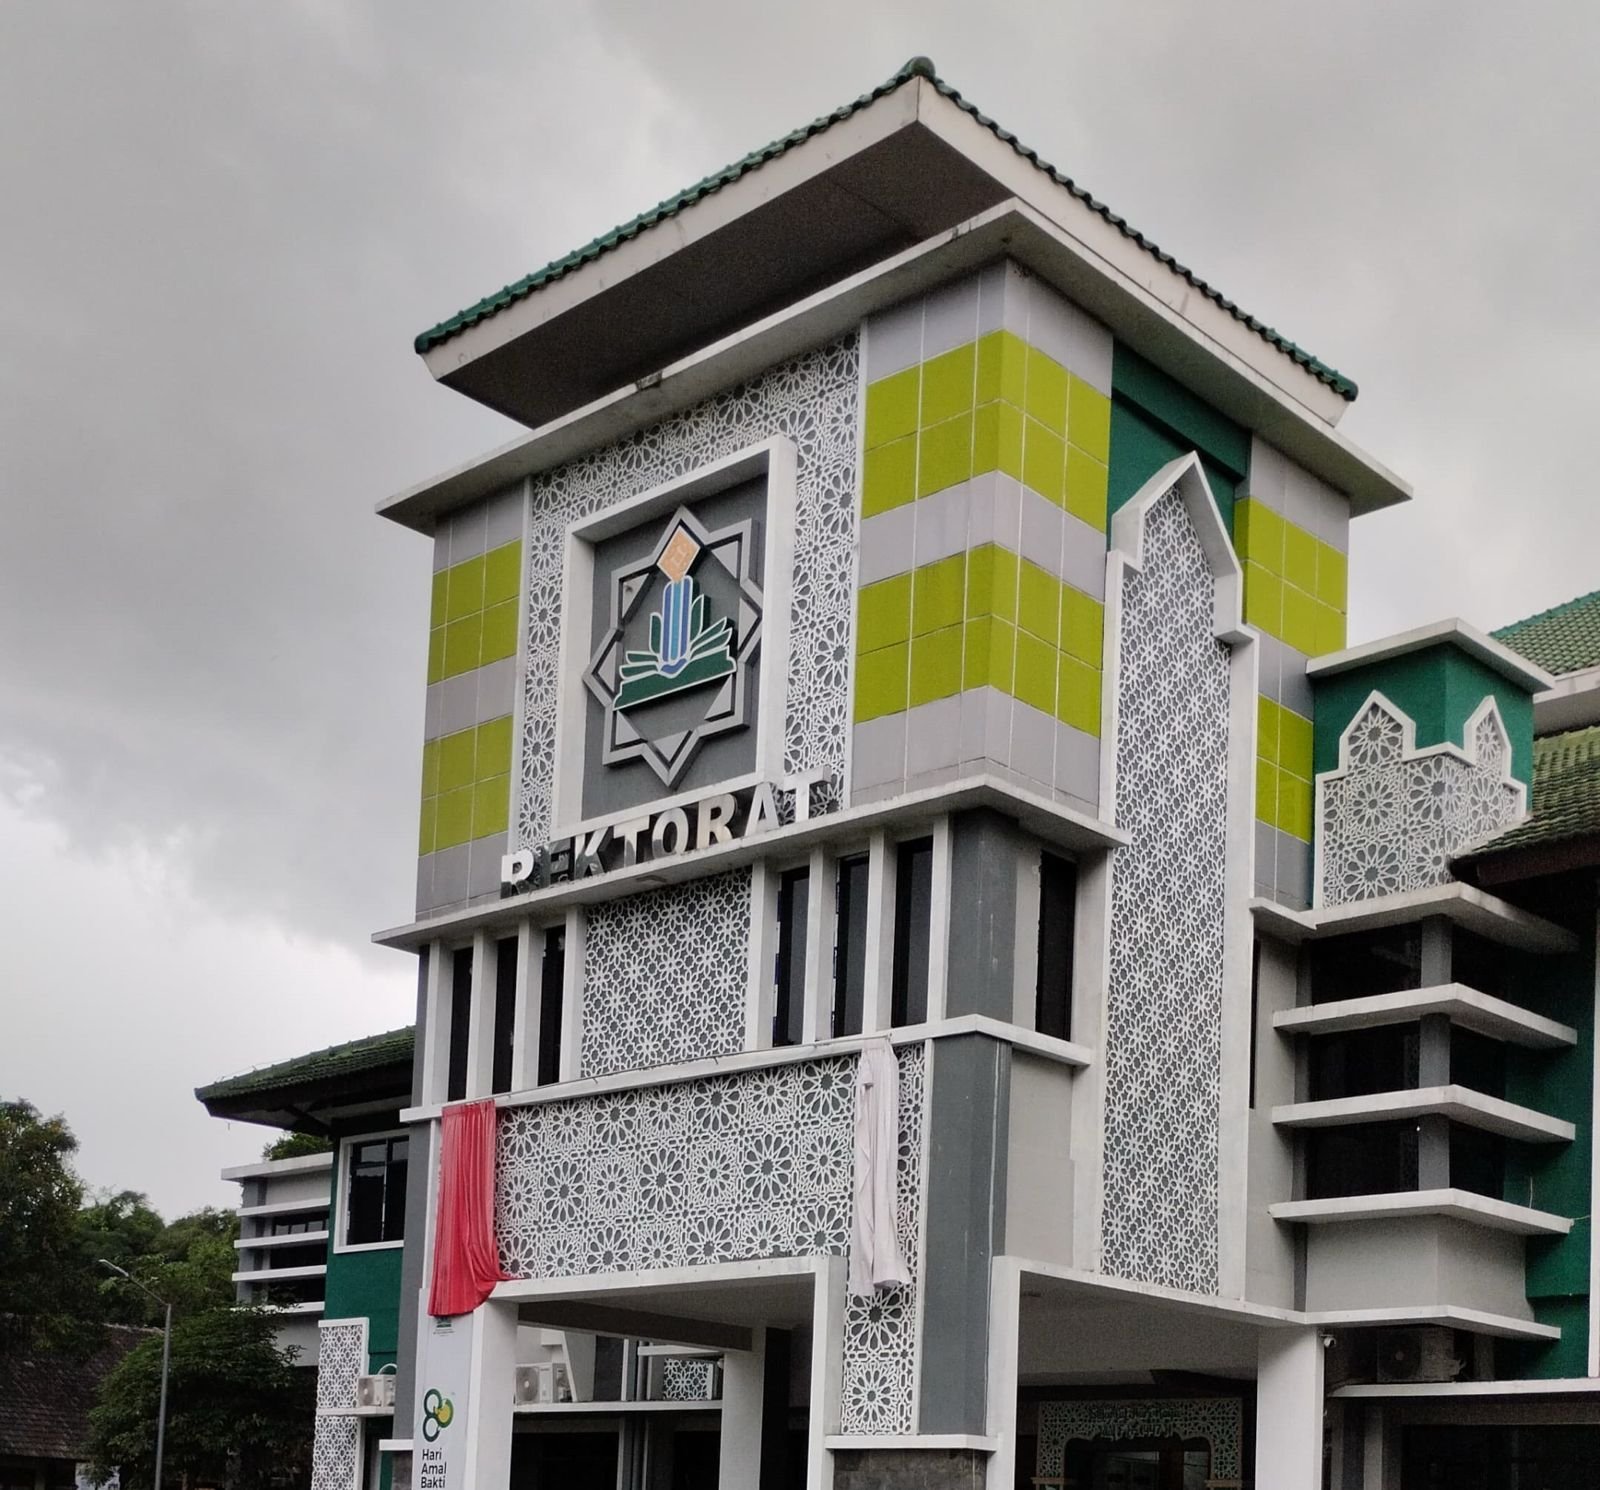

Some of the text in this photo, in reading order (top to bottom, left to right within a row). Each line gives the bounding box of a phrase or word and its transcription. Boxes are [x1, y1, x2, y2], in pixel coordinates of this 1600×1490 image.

[500, 764, 830, 900] REKTORAT
[422, 1448, 442, 1461] Hari
[421, 1461, 447, 1475] Amal
[420, 1475, 446, 1489] Bakti
